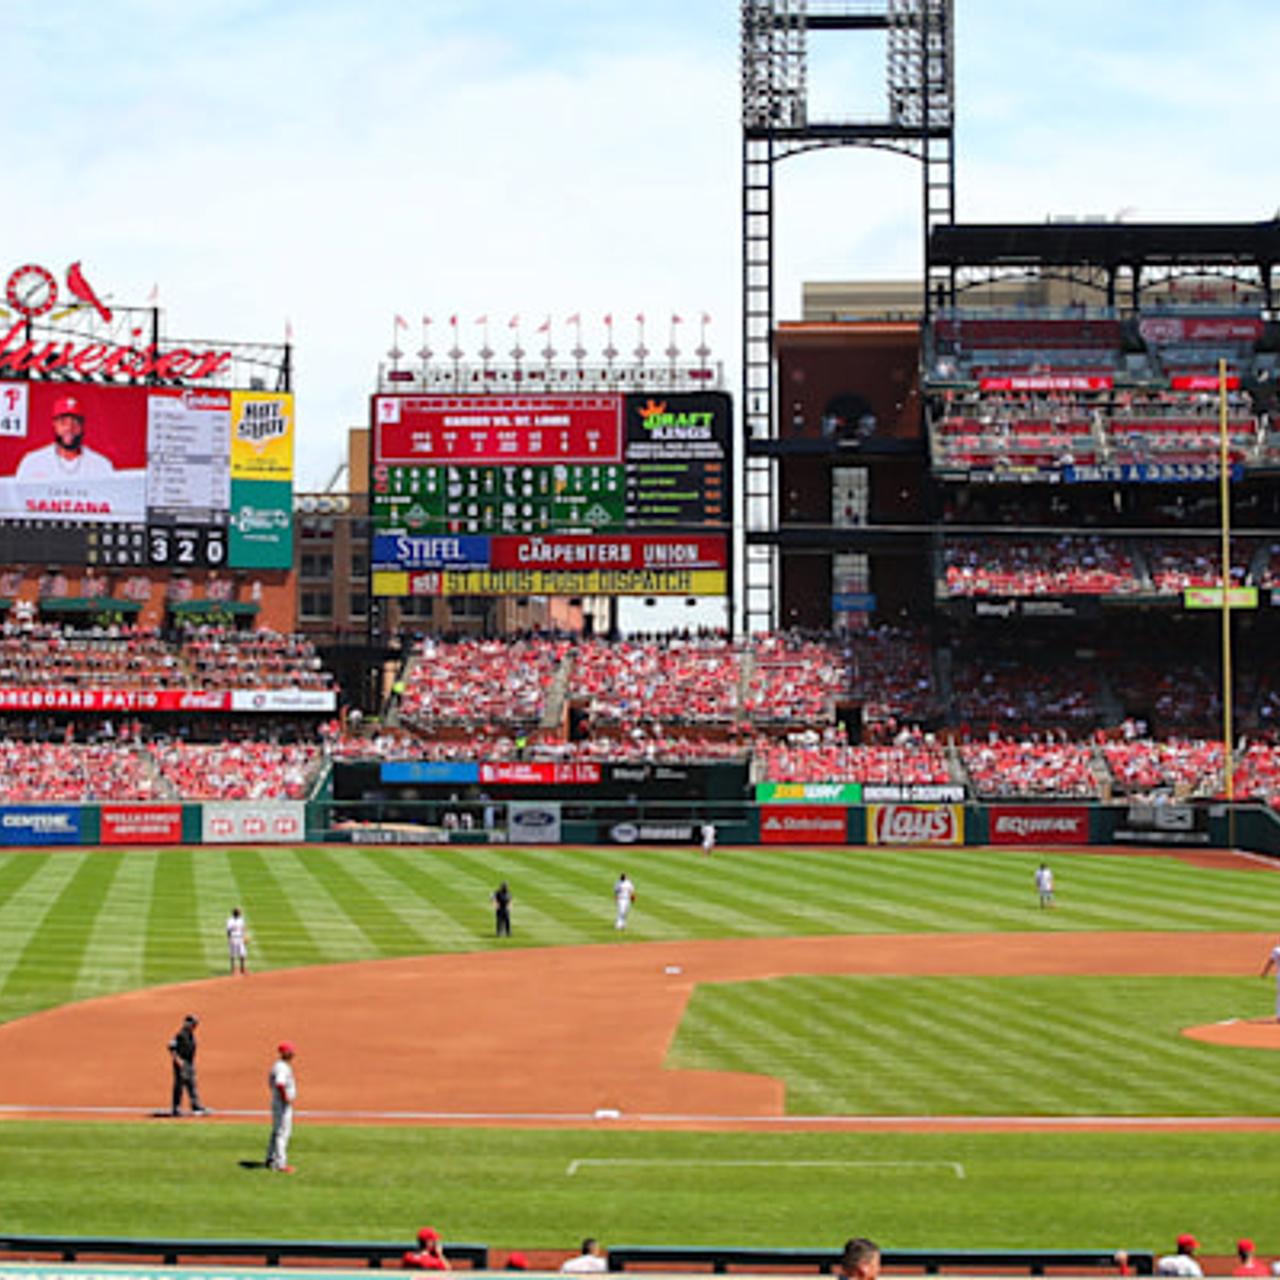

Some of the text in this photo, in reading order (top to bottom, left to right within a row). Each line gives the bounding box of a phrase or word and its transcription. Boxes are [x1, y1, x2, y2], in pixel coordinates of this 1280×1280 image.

[643, 413, 713, 429] DRAFT
[26, 499, 111, 514] SANTANA
[152, 541, 168, 562] 3
[179, 542, 194, 562] 2
[207, 542, 222, 563] 0
[397, 538, 462, 560] STIFEL
[519, 543, 698, 561] CARPENTERS UNION
[480, 571, 532, 592] LOUIS
[541, 570, 692, 592] POST-DISPATCH
[102, 691, 158, 707] PATIO
[774, 785, 845, 798] SUBWAY
[995, 816, 1080, 835] EQUIFAX
